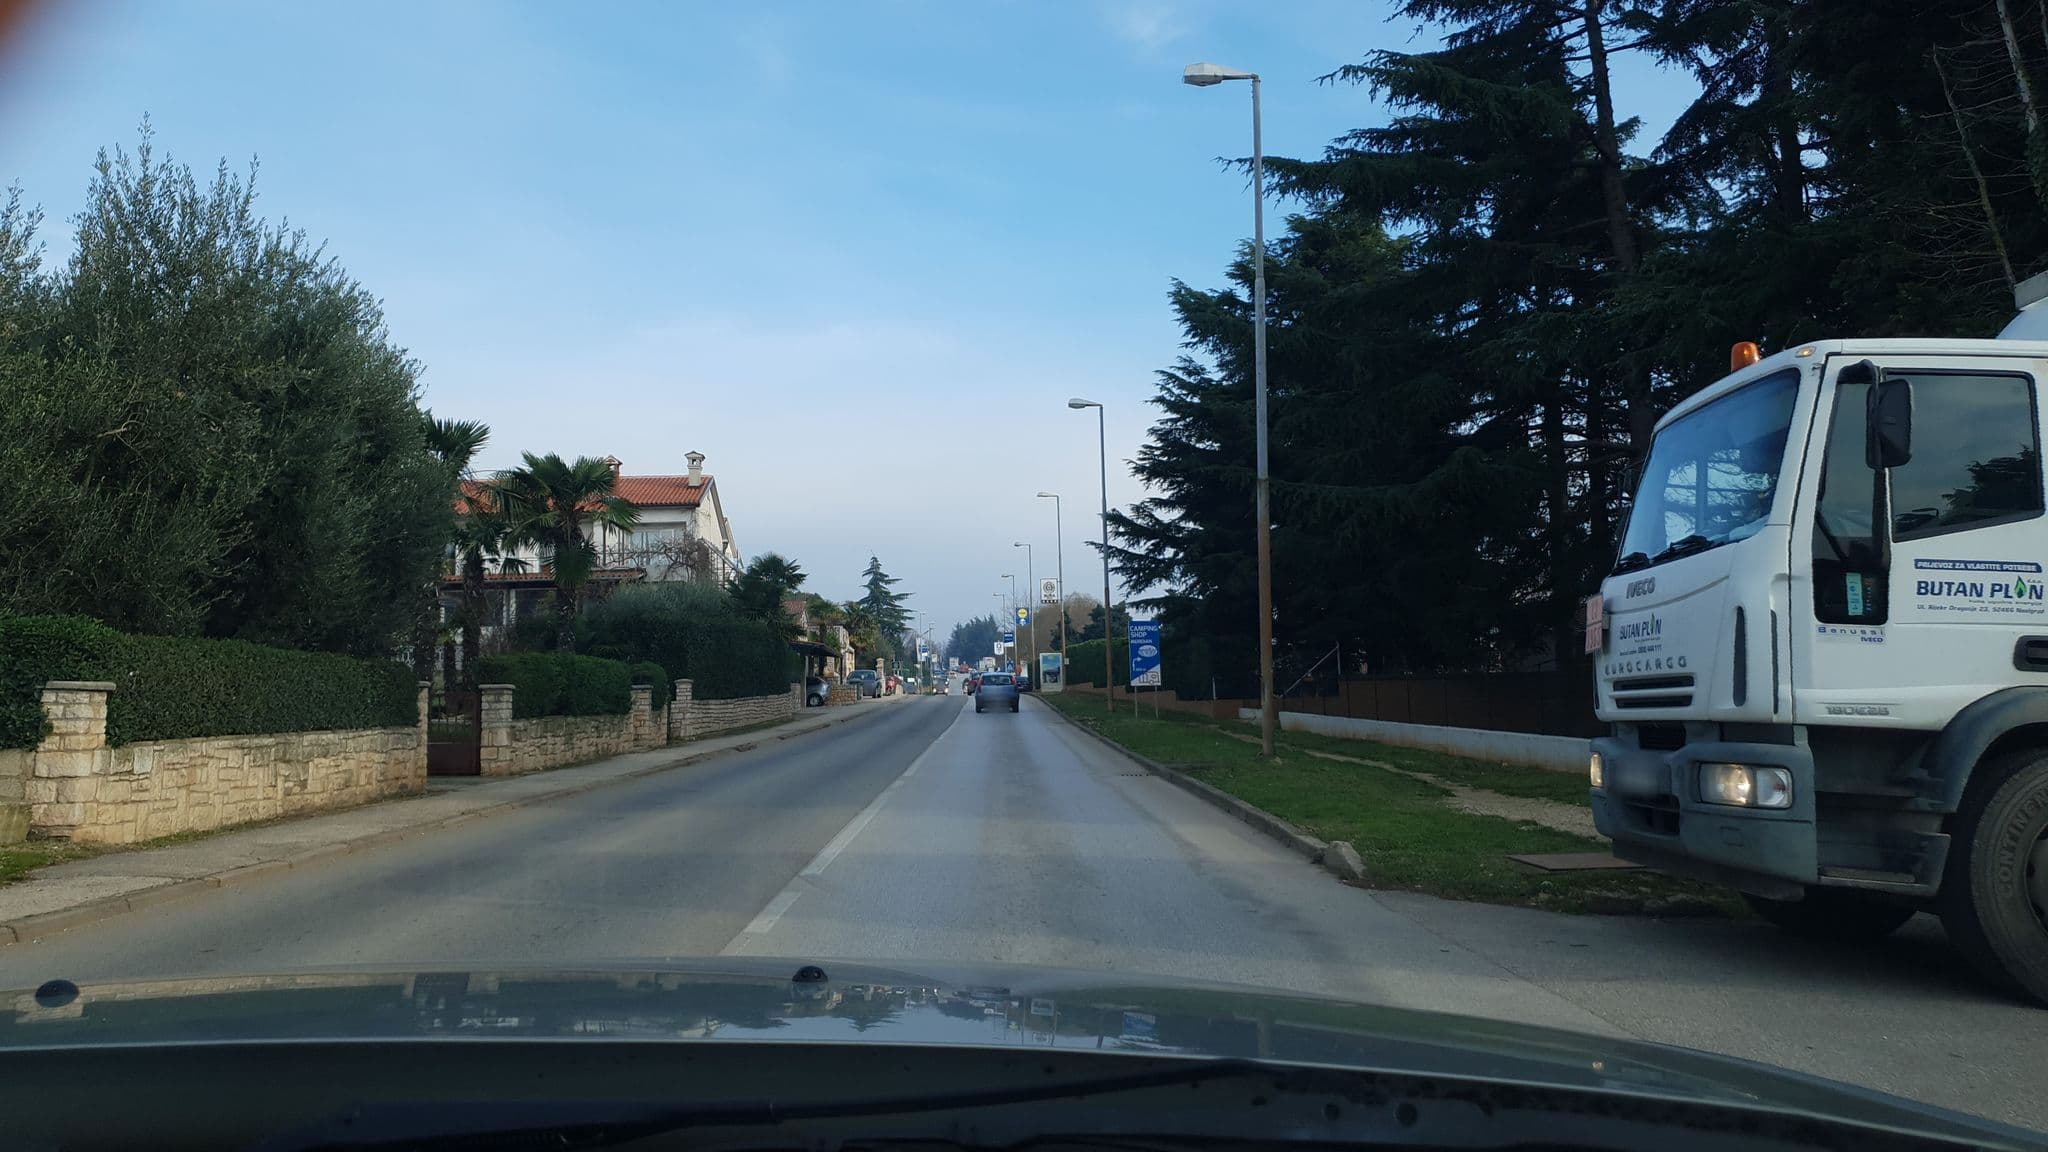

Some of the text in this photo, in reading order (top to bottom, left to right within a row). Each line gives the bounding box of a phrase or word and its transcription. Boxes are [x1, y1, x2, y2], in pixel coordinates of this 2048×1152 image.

[1626, 577, 1656, 599] IVECO
[1916, 580, 1984, 598] BUTAN
[1619, 621, 1640, 640] BUTAN
[1818, 626, 1884, 635] Benussi
[1605, 656, 1688, 675] EUROCARGO
